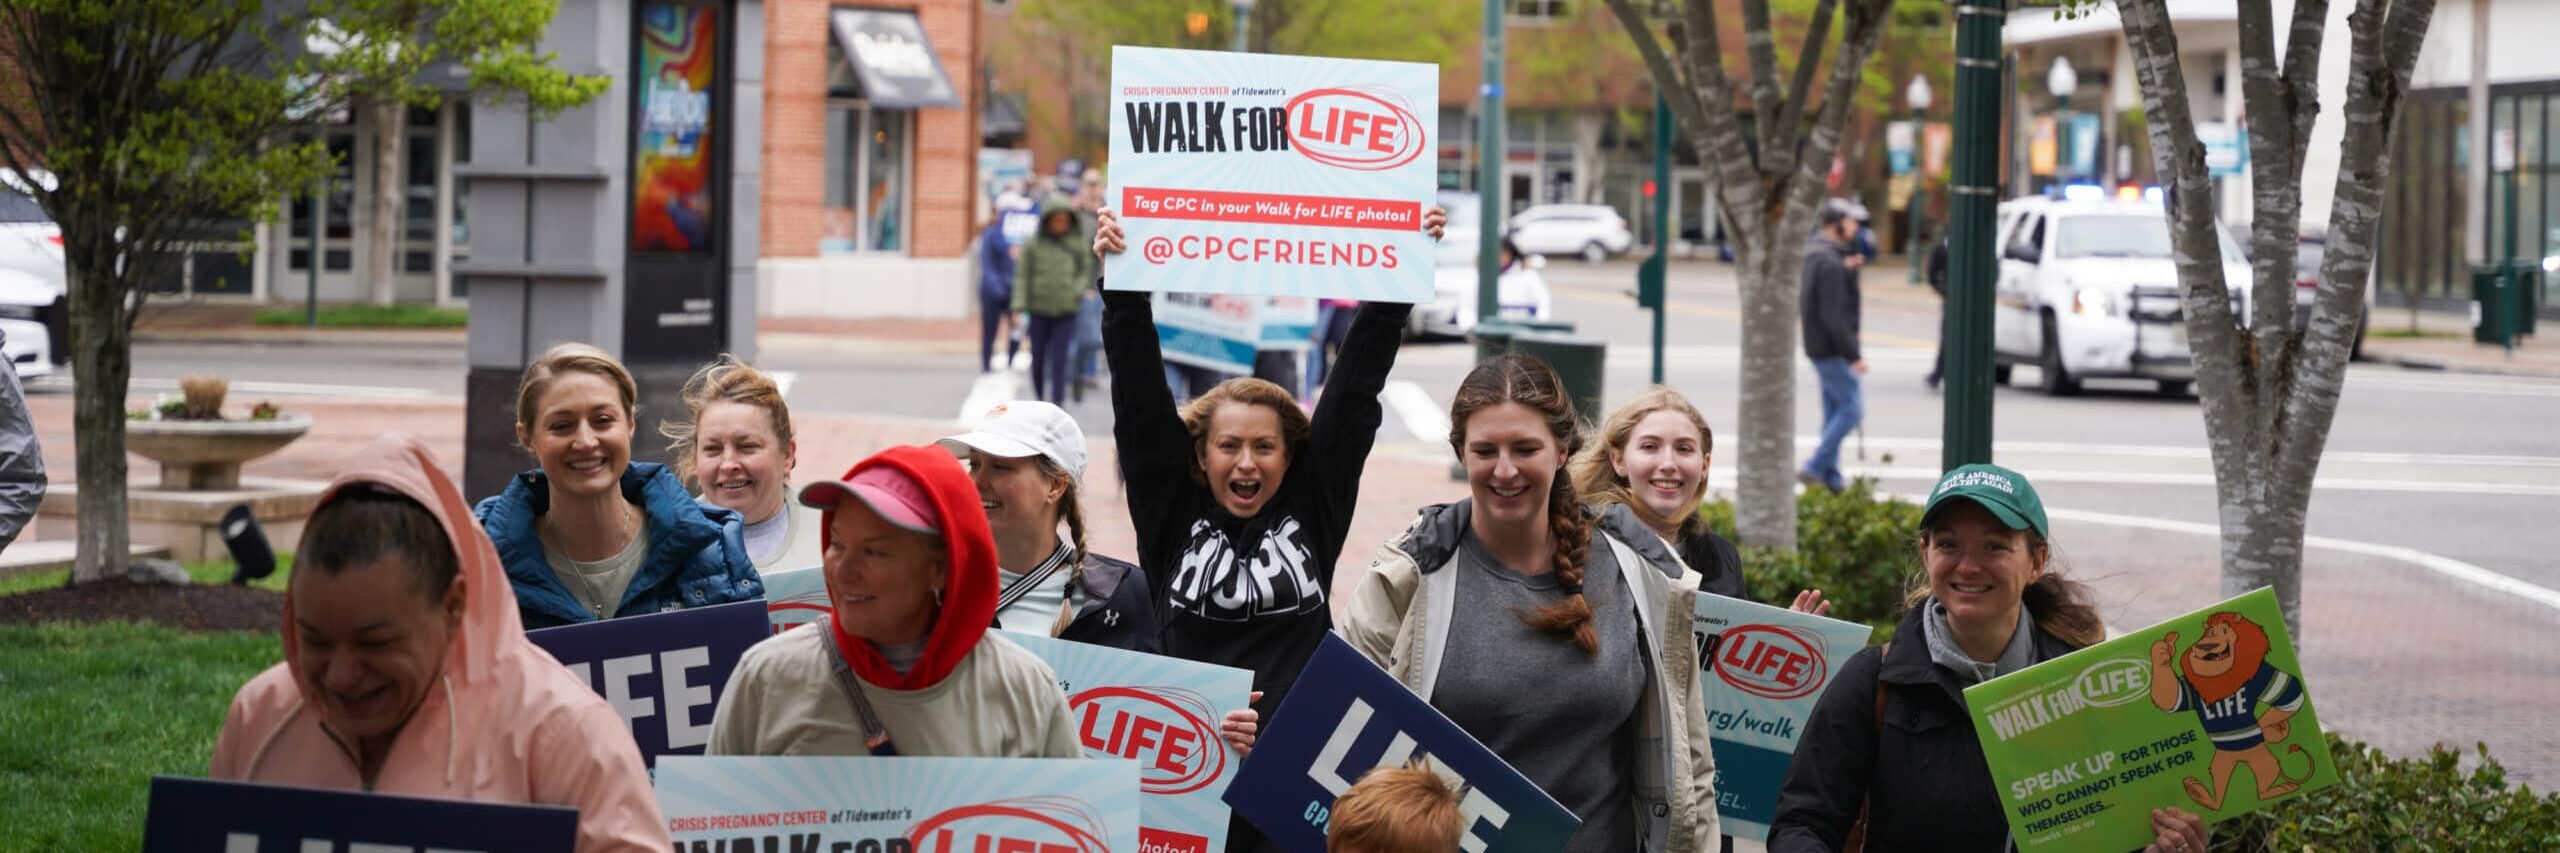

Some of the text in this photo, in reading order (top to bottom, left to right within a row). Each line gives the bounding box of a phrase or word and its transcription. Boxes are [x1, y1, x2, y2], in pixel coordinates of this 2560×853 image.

[1123, 86, 1287, 96] CRISIS PREGNANCY CENTER of Tidewater's
[1125, 101, 1399, 153] WALK FOR LIFE
[1134, 195, 1412, 223] Tag CPC in your Walk for LIFE photos!
[1143, 235, 1398, 269] @CPCFRIENDS
[1170, 516, 1323, 617] HOPE
[1724, 633, 1810, 687] LIFE
[566, 646, 713, 749] FE
[1986, 694, 2050, 742] WALK
[2047, 684, 2086, 720] FOR
[2084, 665, 2144, 698] LIFE
[2200, 687, 2247, 720] LIFE
[1079, 701, 1197, 776] LIFE
[2011, 729, 2197, 800] SPEAK UP FOR THOSE
[2018, 750, 2195, 818] WHO CANNOT SPEAK FOR
[669, 807, 912, 832] CRISIS PREGNANCY CENTER of Tidewater's
